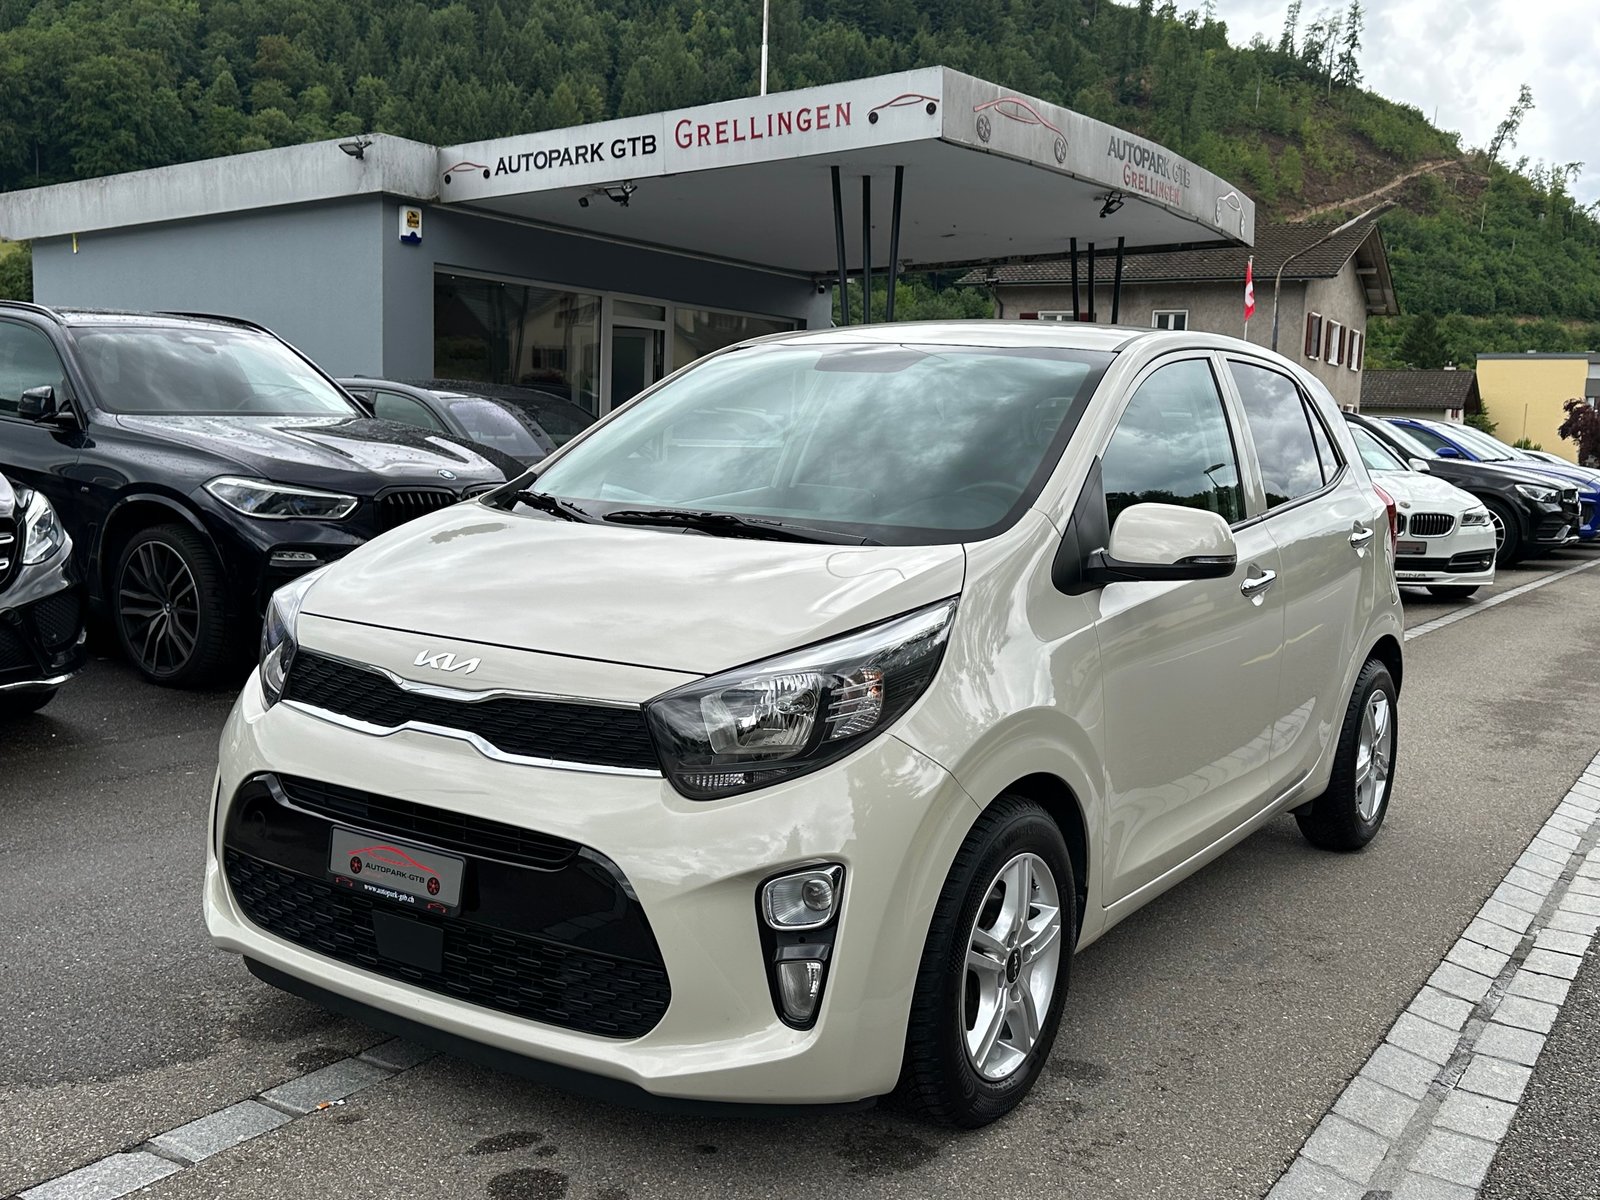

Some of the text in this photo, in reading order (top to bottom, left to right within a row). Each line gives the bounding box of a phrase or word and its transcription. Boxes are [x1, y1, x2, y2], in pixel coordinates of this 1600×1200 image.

[675, 101, 852, 149] GRELLINGEN
[495, 134, 657, 176] AUTOPARK GTB
[1107, 135, 1191, 189] AUTOPARK GTB
[1123, 163, 1180, 205] GRELLINGEN
